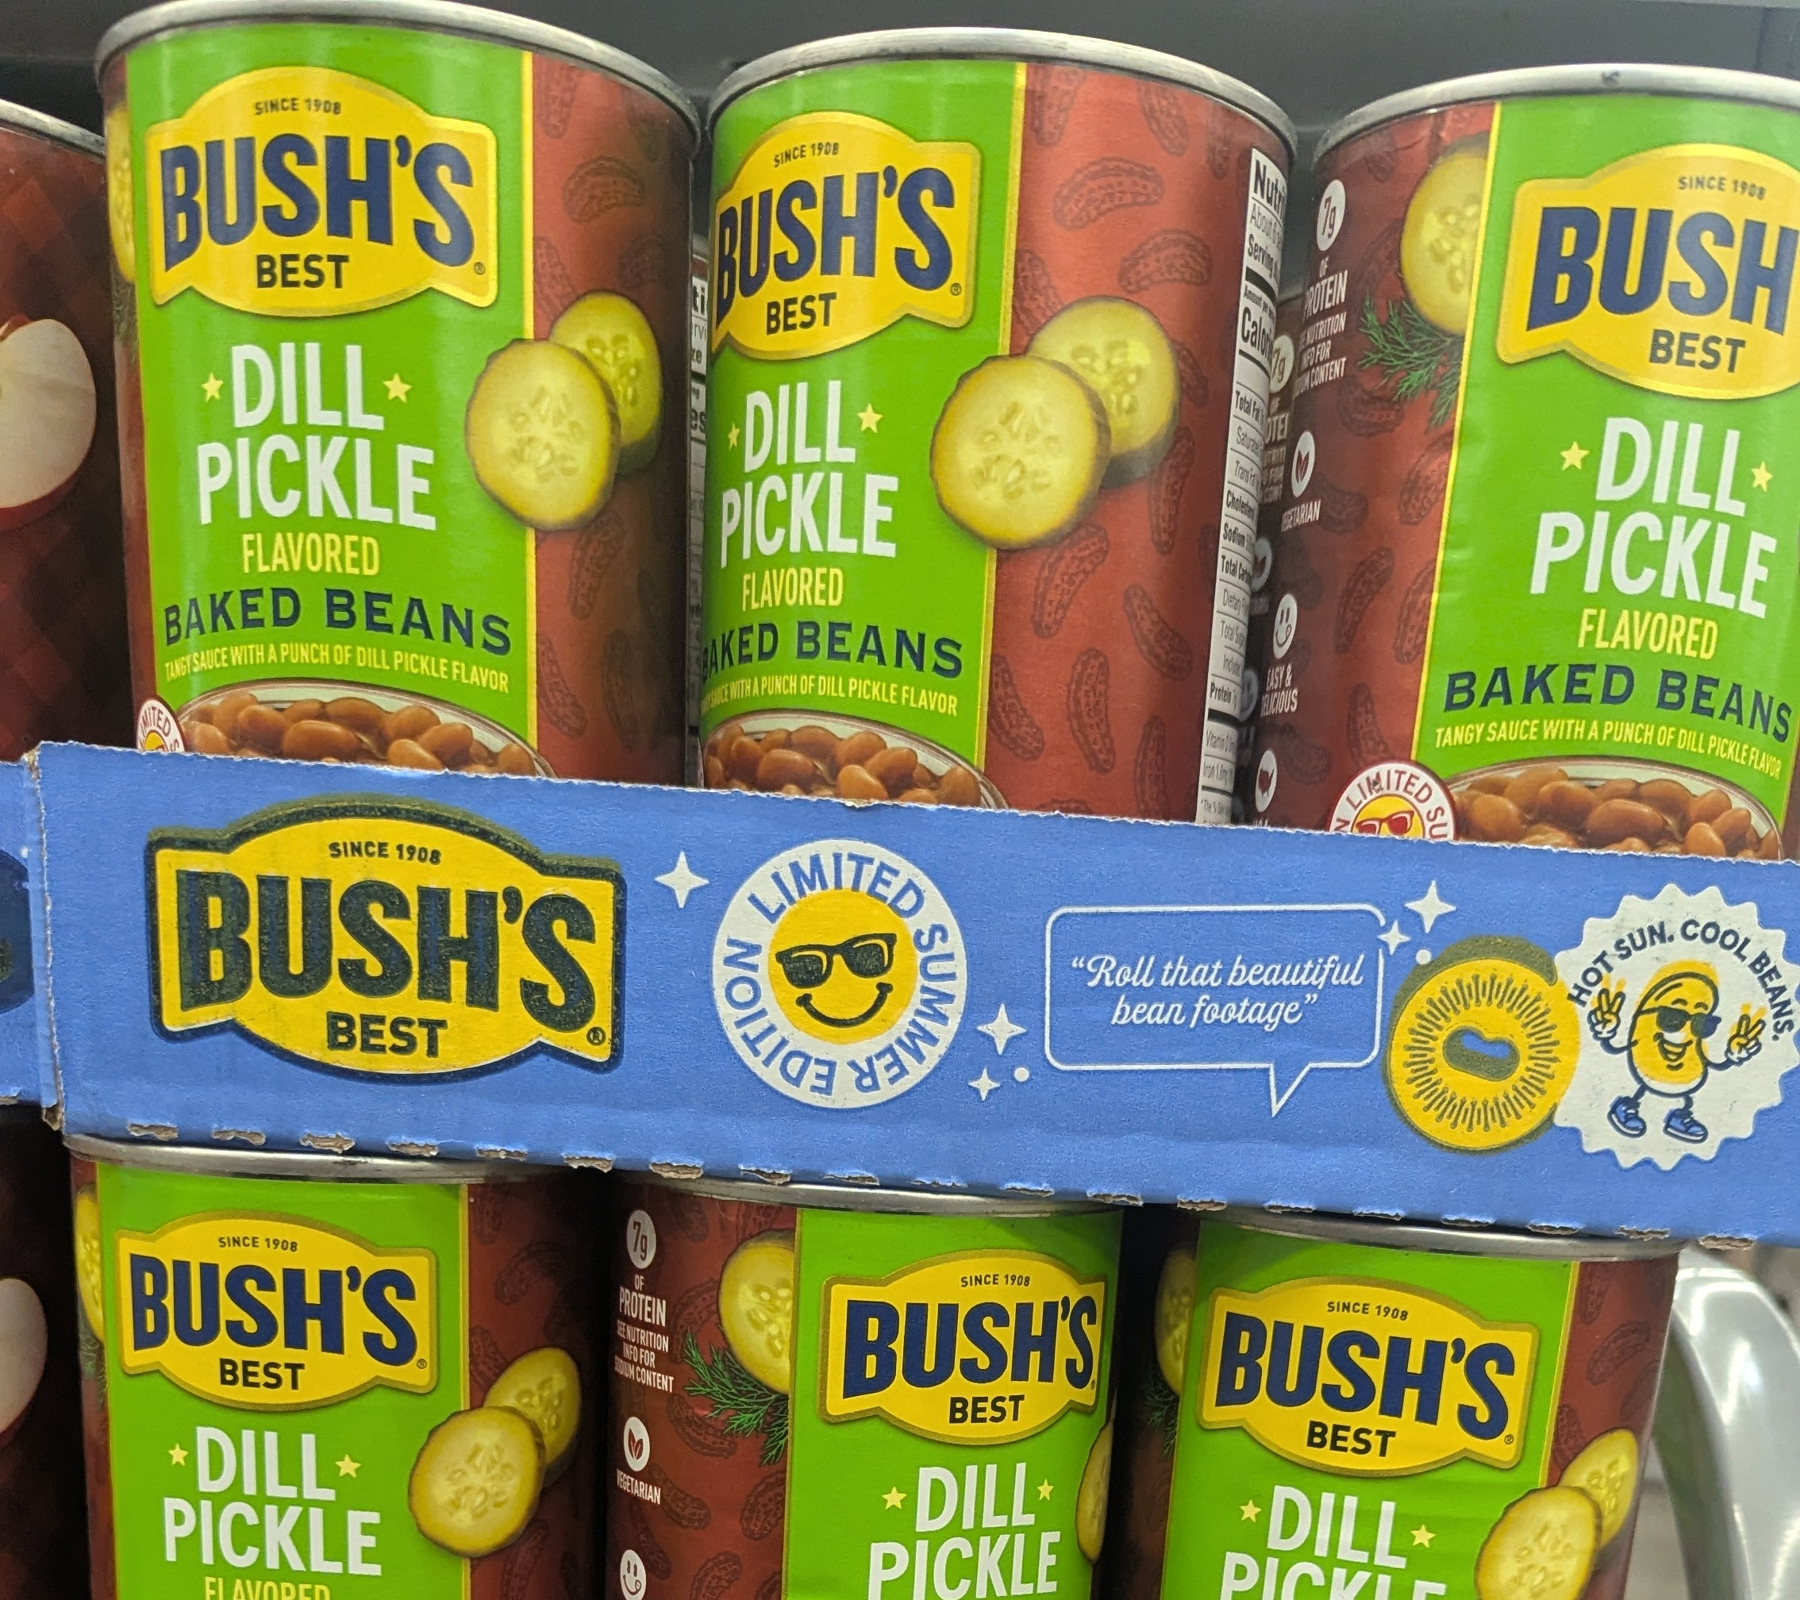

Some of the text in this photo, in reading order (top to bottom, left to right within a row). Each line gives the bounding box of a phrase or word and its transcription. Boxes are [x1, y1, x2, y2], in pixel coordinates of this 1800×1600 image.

[254, 98, 342, 116] SINCE 1908
[774, 142, 839, 167] SINCE 1908
[159, 133, 477, 272] BUSH'S
[1678, 174, 1766, 199] SINCE 1908
[256, 255, 350, 288] BEST
[715, 167, 954, 331] BUSH'S
[766, 293, 837, 335] BEST
[1649, 330, 1746, 374] BEST
[231, 342, 384, 431] DILL
[744, 380, 855, 470] DILL
[197, 435, 436, 530] PICKLE
[1595, 417, 1746, 514] DILL
[722, 474, 898, 568] PICKLE
[242, 533, 379, 575] FLAVORED
[1531, 512, 1777, 619] PICKLE
[742, 568, 843, 610] FLAVORED
[164, 587, 512, 656] BAKED BEANS
[1578, 609, 1717, 660] FLAVORED
[796, 621, 962, 679] BEANS
[1443, 664, 1792, 743] BAKED BEANS
[329, 841, 442, 865] SINCE 1908
[748, 852, 925, 924] LIMITED
[175, 869, 596, 1033] BUSH'S
[1072, 954, 1364, 989] “Roll that beautiful
[1567, 918, 1795, 1041] HOT SUN. COOL BEANS.
[722, 938, 838, 1096] EDITION
[847, 923, 956, 1094] SUMMER
[1111, 993, 1318, 1032] bean footage”
[327, 1011, 447, 1058] BEST
[218, 1235, 298, 1254] SINCE 1908
[633, 1220, 647, 1261] 7g
[634, 1273, 644, 1291] OF
[960, 1274, 1030, 1288] SINCE 1908
[130, 1253, 418, 1366] BUSH'S
[619, 1285, 667, 1327] PROTEIN
[1327, 1300, 1409, 1321] SINCE 1908
[623, 1341, 655, 1368] INFO FOR
[626, 1323, 669, 1353] NUTRITION
[843, 1296, 1097, 1398] BUSH'S
[220, 1358, 305, 1390] BEST
[1215, 1312, 1516, 1441] BUSH'S
[948, 1394, 1025, 1425] BEST
[196, 1426, 336, 1501] DILL
[1306, 1421, 1396, 1457] BEST
[616, 1468, 661, 1505] VEGETARIAN
[915, 1462, 1035, 1533] DILL
[163, 1496, 381, 1576] PICKLE
[1267, 1485, 1407, 1569] DILL
